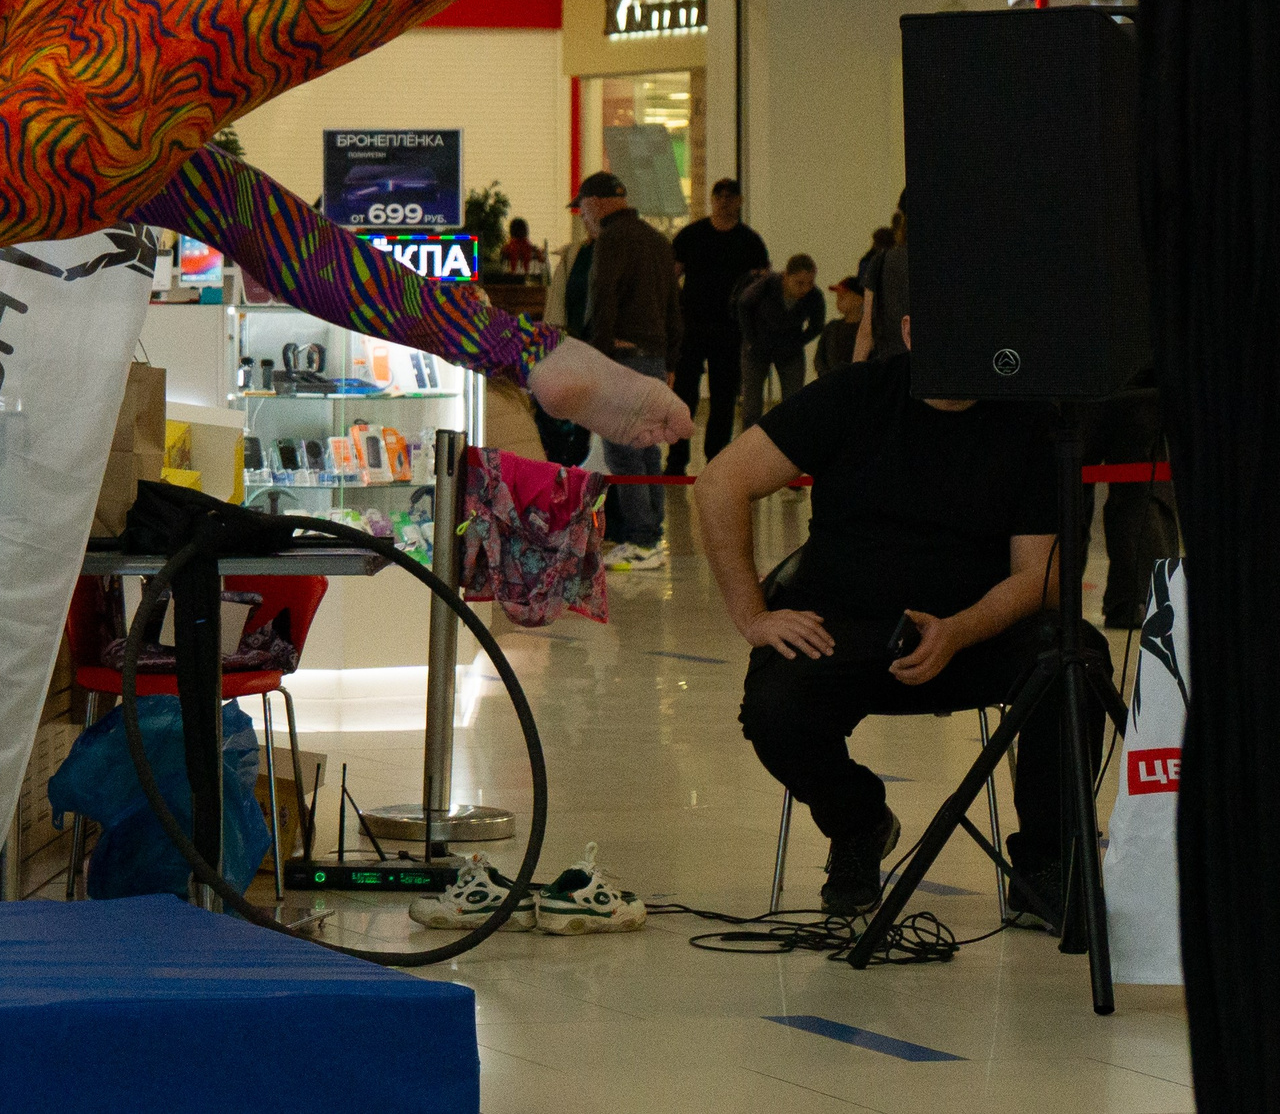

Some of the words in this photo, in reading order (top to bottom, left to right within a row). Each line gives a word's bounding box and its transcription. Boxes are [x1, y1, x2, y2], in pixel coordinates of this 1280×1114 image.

[336, 132, 444, 147] БРОНЕПЛЁНКА
[351, 214, 365, 223] ОТ
[368, 203, 423, 224] 699
[424, 214, 447, 224] РУБ.
